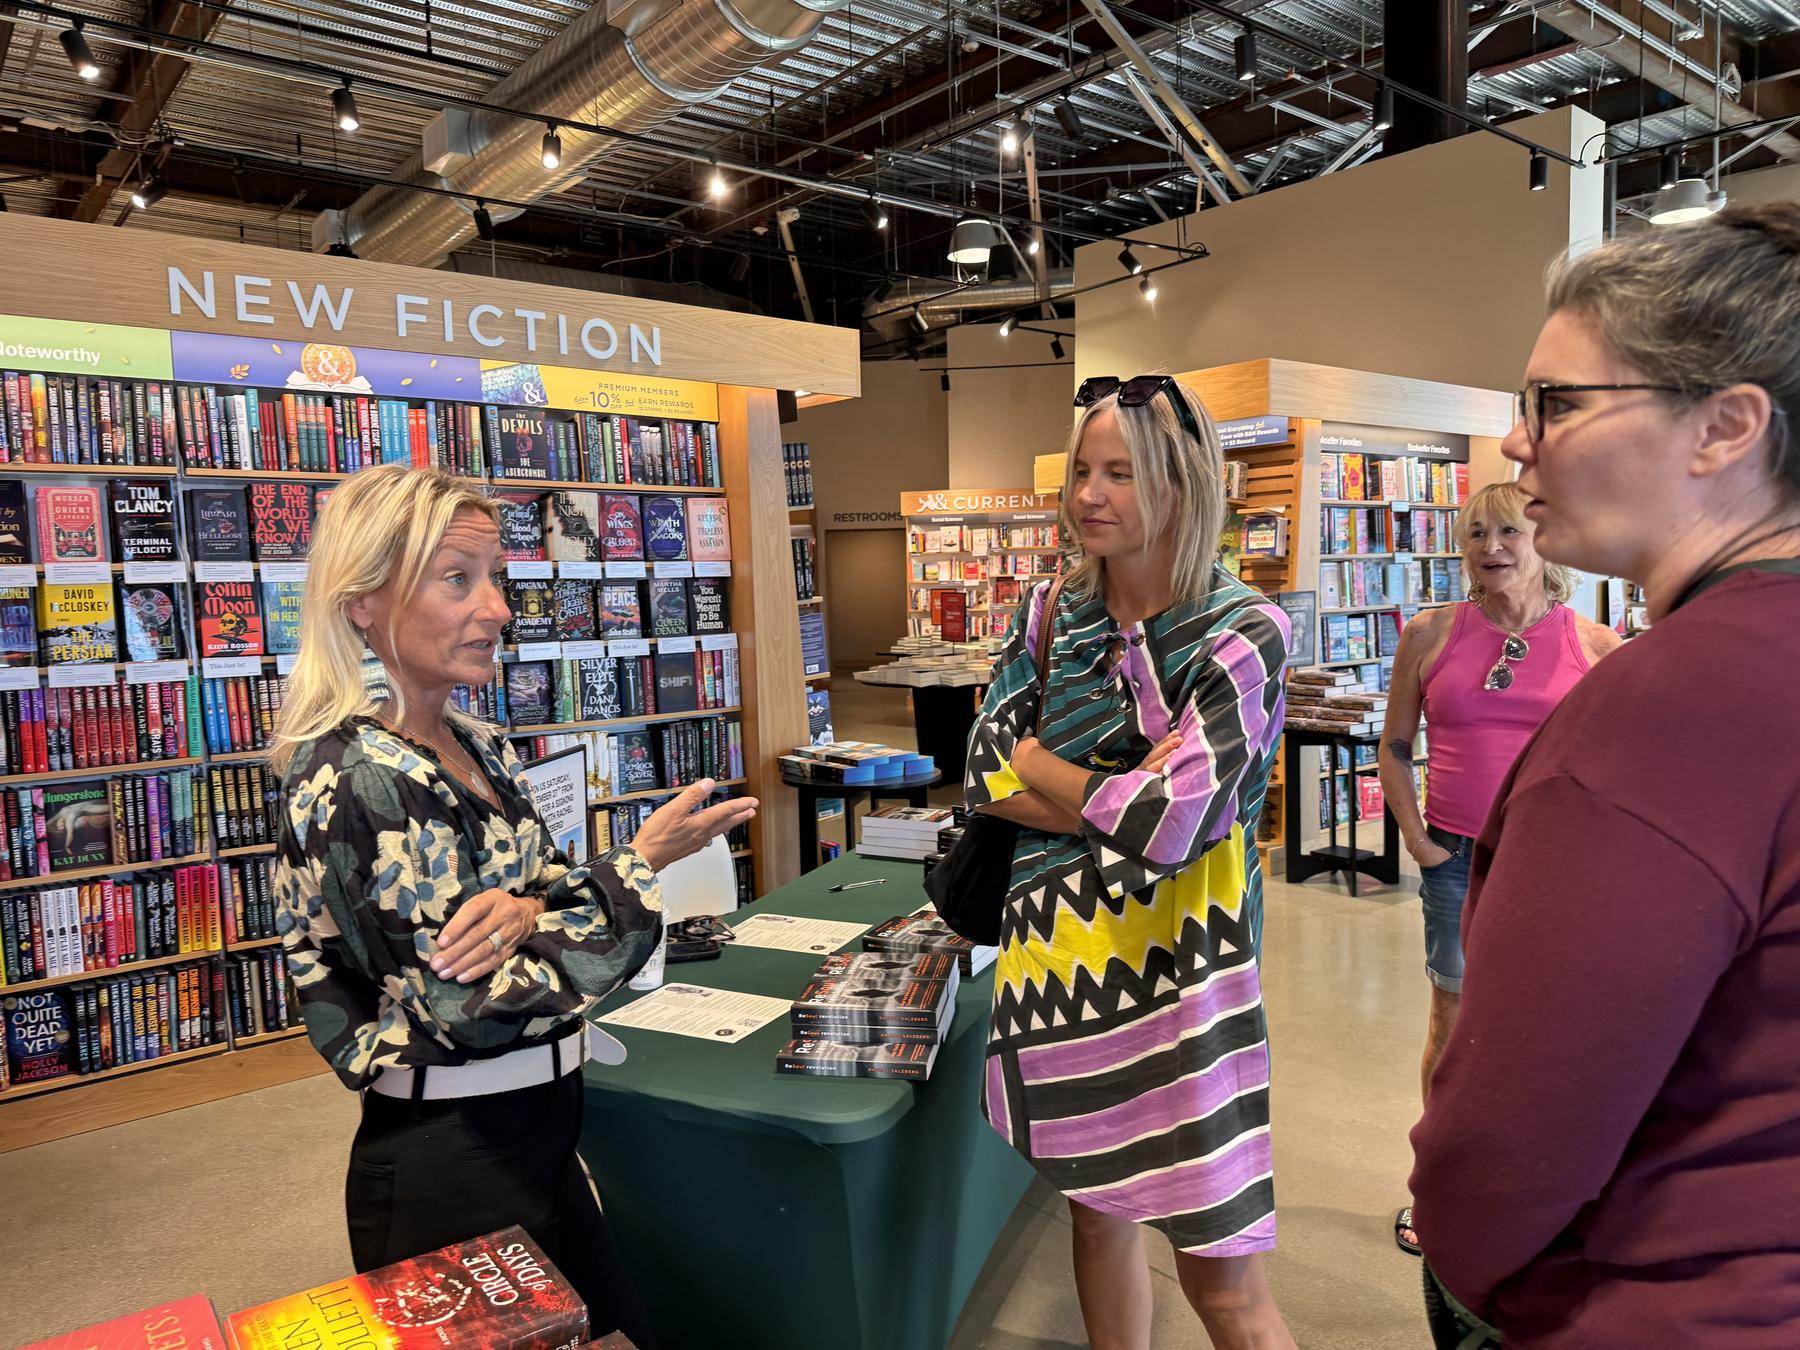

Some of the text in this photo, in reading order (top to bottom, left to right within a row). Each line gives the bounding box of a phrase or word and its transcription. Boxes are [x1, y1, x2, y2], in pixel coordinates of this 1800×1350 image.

[168, 266, 662, 366] NEW FICTION
[598, 382, 679, 397] PREMIUM MEMBERS
[48, 387, 59, 425] SANDRA BROWN
[638, 397, 658, 406] EARN
[660, 399, 694, 409] REWARDS
[101, 396, 113, 454] BURKE CLETE
[501, 418, 543, 435] DEVILS
[1256, 428, 1279, 436] Rewards
[372, 429, 381, 447] ESCAPE
[613, 417, 623, 464] OLIVIE BLAKE
[1339, 437, 1362, 447] Favorites
[1407, 443, 1450, 454] Bookseller Favorites
[520, 458, 530, 467] JOE
[505, 467, 547, 478] ABERCROMBIE
[127, 486, 160, 500] TOM
[251, 484, 307, 495] THE END
[114, 499, 173, 513] CLANCY
[251, 495, 308, 508] OF THE
[953, 493, 1048, 511] CURRENT
[55, 506, 92, 514] ORIENT
[200, 509, 237, 519] LIBRARY
[253, 507, 310, 520] WORLD
[834, 511, 904, 523] RESTROOMS
[255, 520, 312, 533] AS WE
[607, 519, 633, 529] WINGS
[648, 519, 680, 528] WRATH
[123, 537, 172, 547] TERMINAL
[255, 532, 297, 544] KNOW
[606, 537, 637, 548] BLOOD
[123, 545, 173, 555] VELOCITY
[204, 582, 252, 597] Coffin
[515, 581, 548, 590] ARCANA
[699, 586, 714, 595] You
[63, 589, 94, 600] DAVID
[605, 591, 637, 606] PEACE
[693, 594, 721, 604] Weren't
[50, 601, 110, 612] McCLOSKEY
[204, 597, 256, 615] Moon
[696, 603, 721, 613] Meant
[269, 611, 299, 621] IN HER
[515, 617, 552, 626] ACADEMY
[655, 617, 685, 627] QUEEN
[698, 612, 720, 621] to Be
[655, 626, 688, 636] DEMON
[696, 620, 724, 630] Human
[71, 631, 94, 642] THE
[52, 643, 113, 660] PERSIAN
[581, 658, 618, 670] SILVER
[659, 676, 694, 689] SHIFT
[589, 695, 614, 705] DANI
[583, 704, 621, 715] FRANCIS
[138, 710, 146, 734] LIARS
[151, 728, 162, 753] CRAIS
[546, 773, 571, 789] SATURDAY
[43, 788, 105, 805] Hungerstone
[536, 790, 552, 804] EMBER
[555, 793, 574, 808] SIGNING
[125, 789, 135, 827] QUIET LIBRARIAN
[211, 770, 228, 839] JAMES PATTERSON PARANOIA
[53, 851, 105, 866] KAT DUNN
[103, 884, 113, 922] SALTWATER
[47, 938, 57, 970] PLAY NICE
[177, 971, 190, 1020] CRAIG JOHNSON
[807, 978, 836, 1005] ReSoul
[18, 992, 55, 1010] NOT
[111, 984, 121, 1024] LISA JEWELL
[12, 1005, 62, 1025] QUITE
[132, 985, 145, 1036] ROY JOHANSEN
[15, 1021, 61, 1040] DEAD
[23, 1036, 55, 1053] YET
[79, 1041, 89, 1061] JANCE
[22, 1056, 60, 1070] HOLLY
[15, 1063, 68, 1080] JACKSON
[890, 1067, 919, 1075] SALZBERG
[496, 1243, 553, 1291] of DAYS
[461, 1252, 519, 1306] CIRCLE
[307, 1286, 378, 1350] LLETT
[143, 1308, 188, 1350] ETS:
[277, 1318, 323, 1350] EN
[435, 1326, 448, 1342] NOVEL
